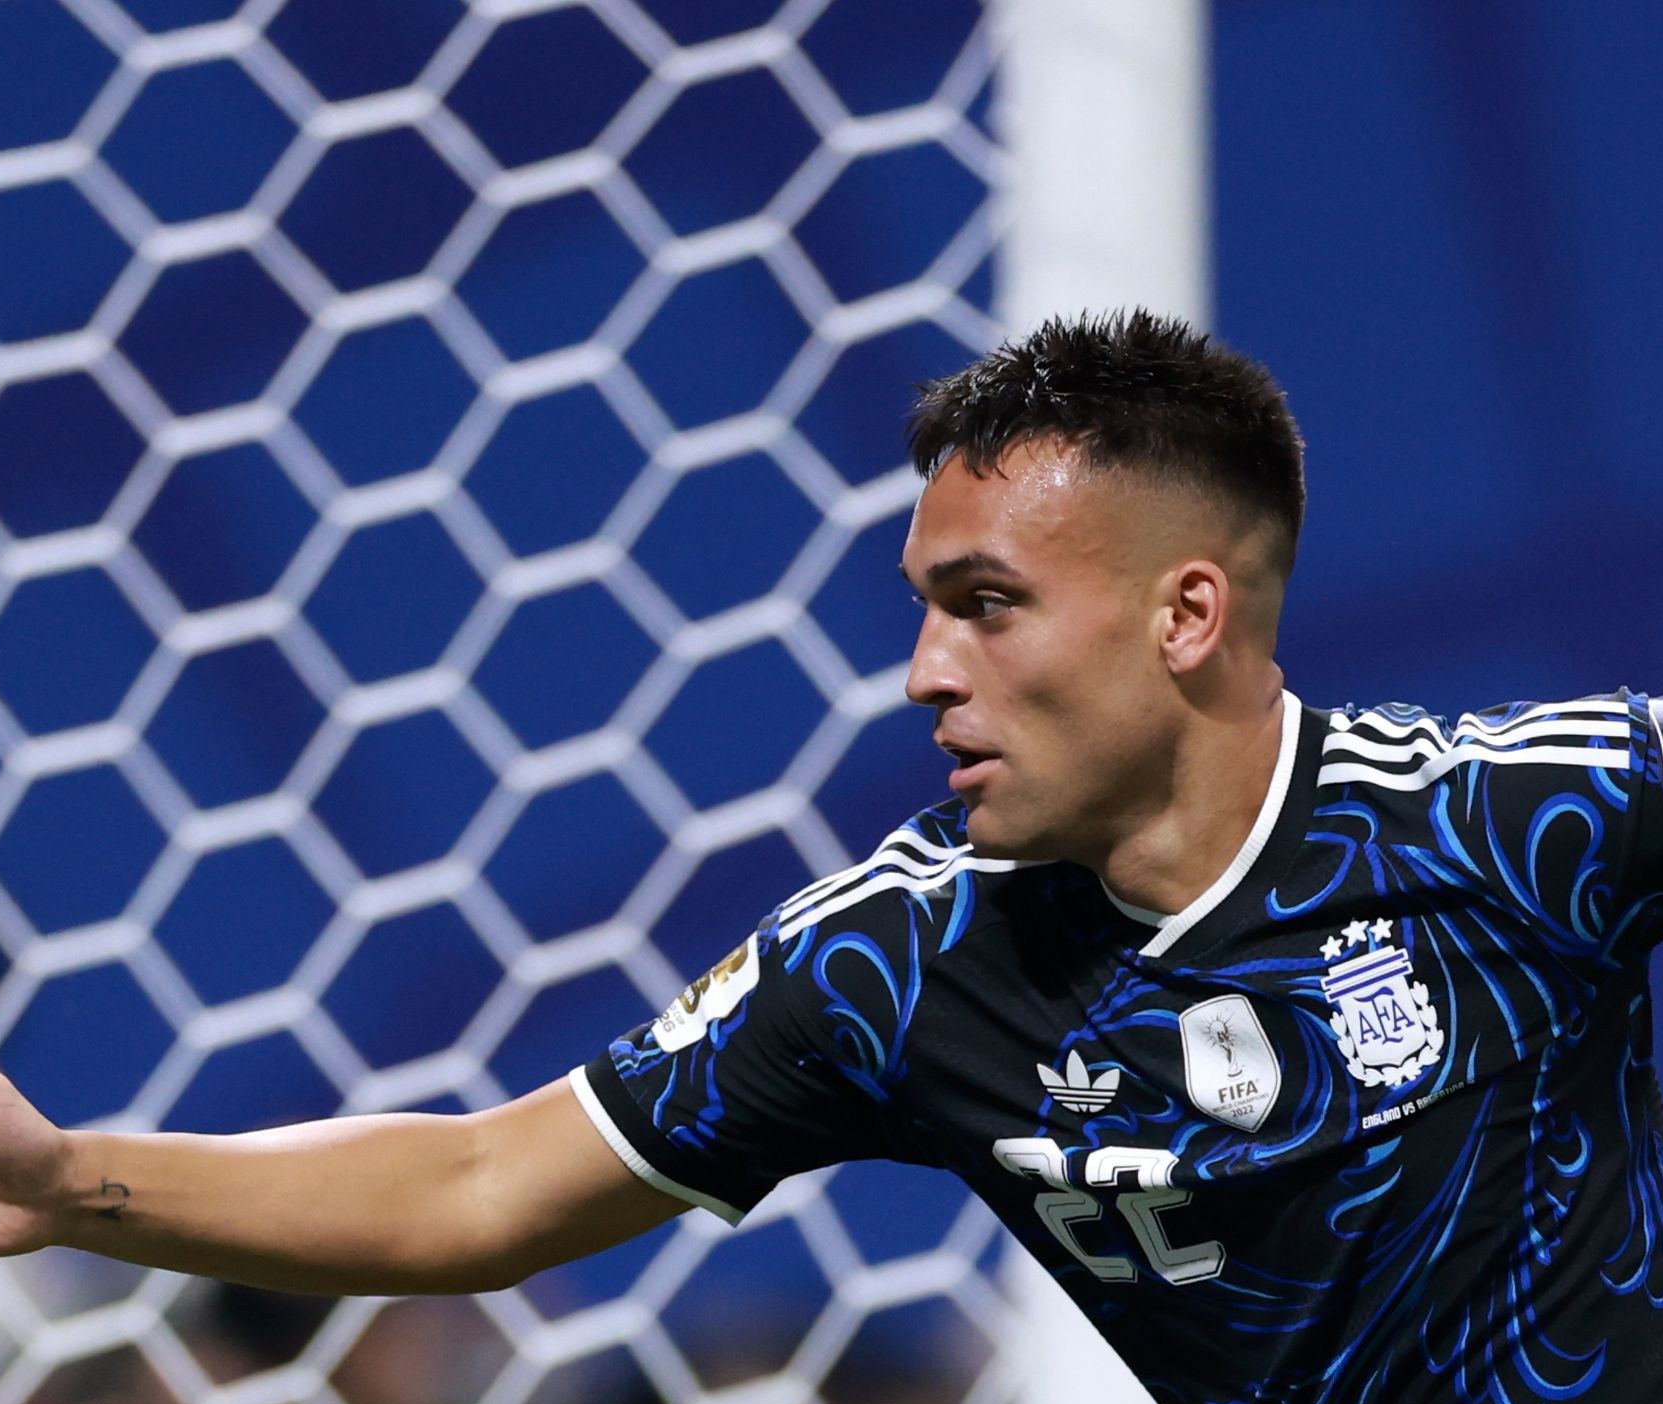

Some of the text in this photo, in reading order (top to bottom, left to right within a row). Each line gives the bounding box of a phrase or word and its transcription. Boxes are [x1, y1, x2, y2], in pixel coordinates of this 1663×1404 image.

[1353, 986, 1416, 1046] AFA
[1218, 1080, 1258, 1104] FIFA
[1231, 1104, 1255, 1118] 2022
[1362, 1106, 1402, 1130] ENGLAND
[1402, 1101, 1416, 1117] VS
[992, 1137, 1227, 1287] 22
